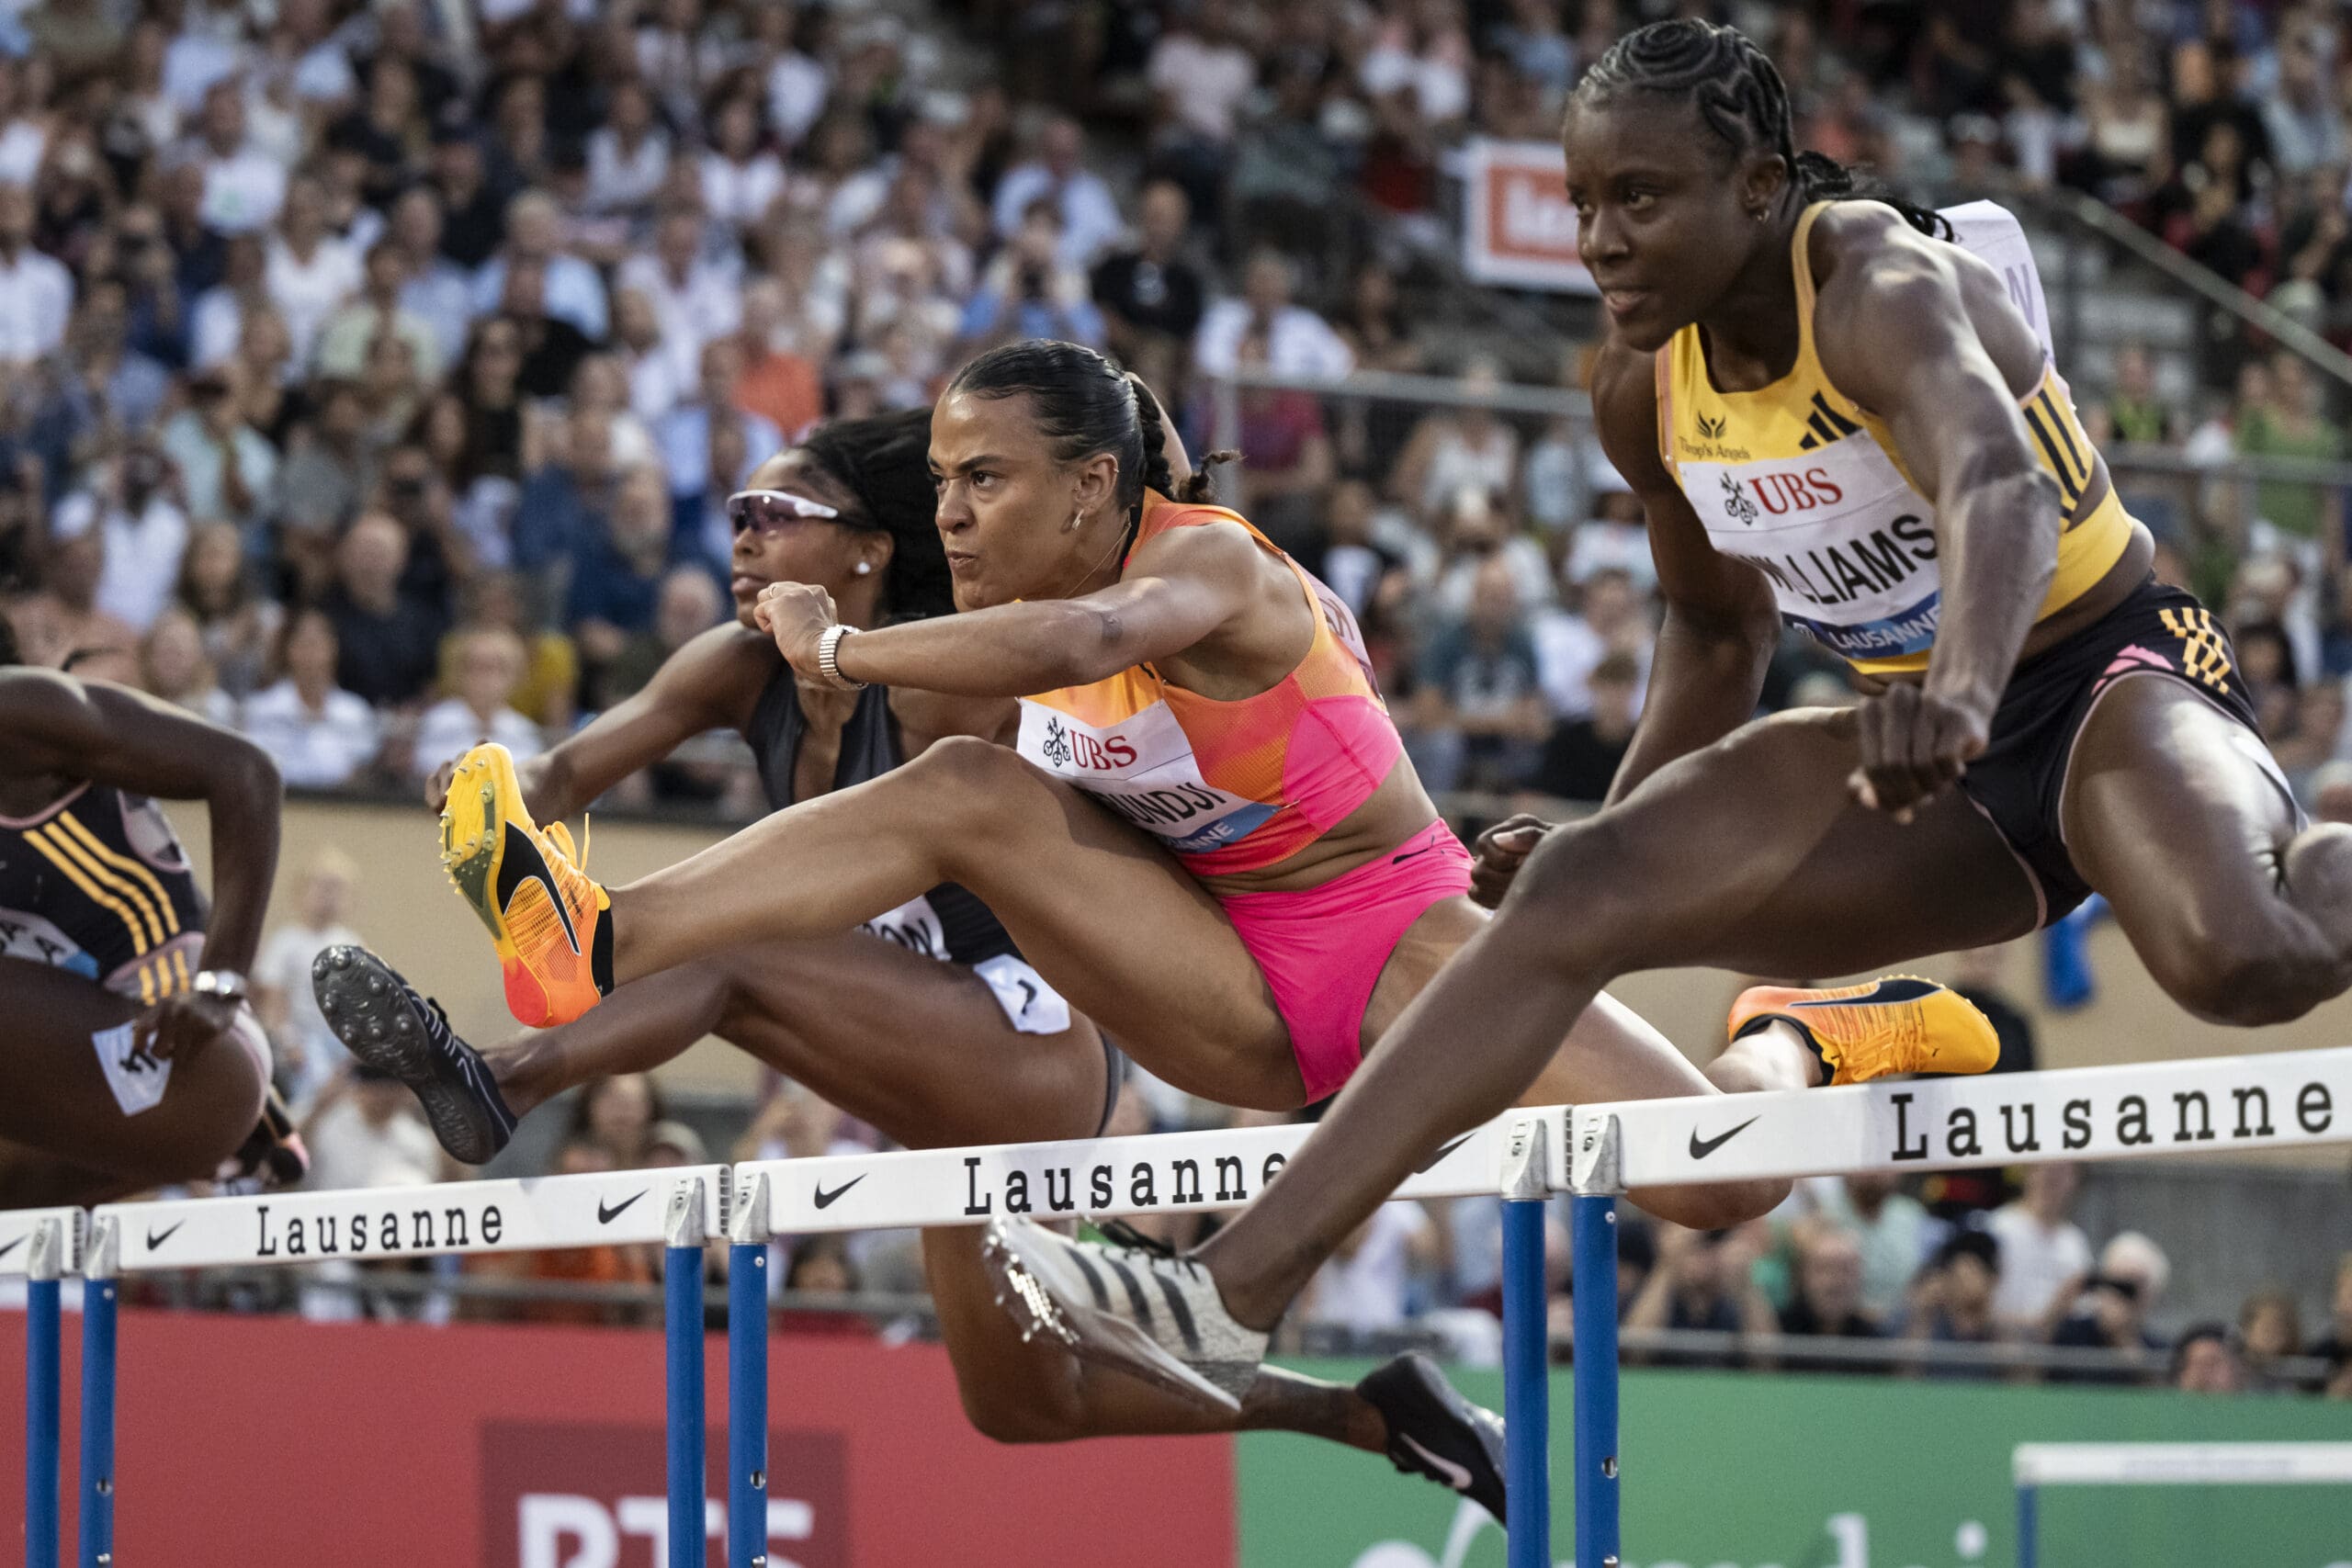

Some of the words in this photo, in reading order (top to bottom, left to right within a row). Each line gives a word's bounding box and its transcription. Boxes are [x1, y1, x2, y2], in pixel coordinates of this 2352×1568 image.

[1716, 443, 1750, 461] Angels
[1748, 468, 1843, 515] UBS
[1069, 729, 1137, 771] UBS
[1891, 1080, 2333, 1161] Lausanne
[256, 1203, 503, 1257] Lausanne
